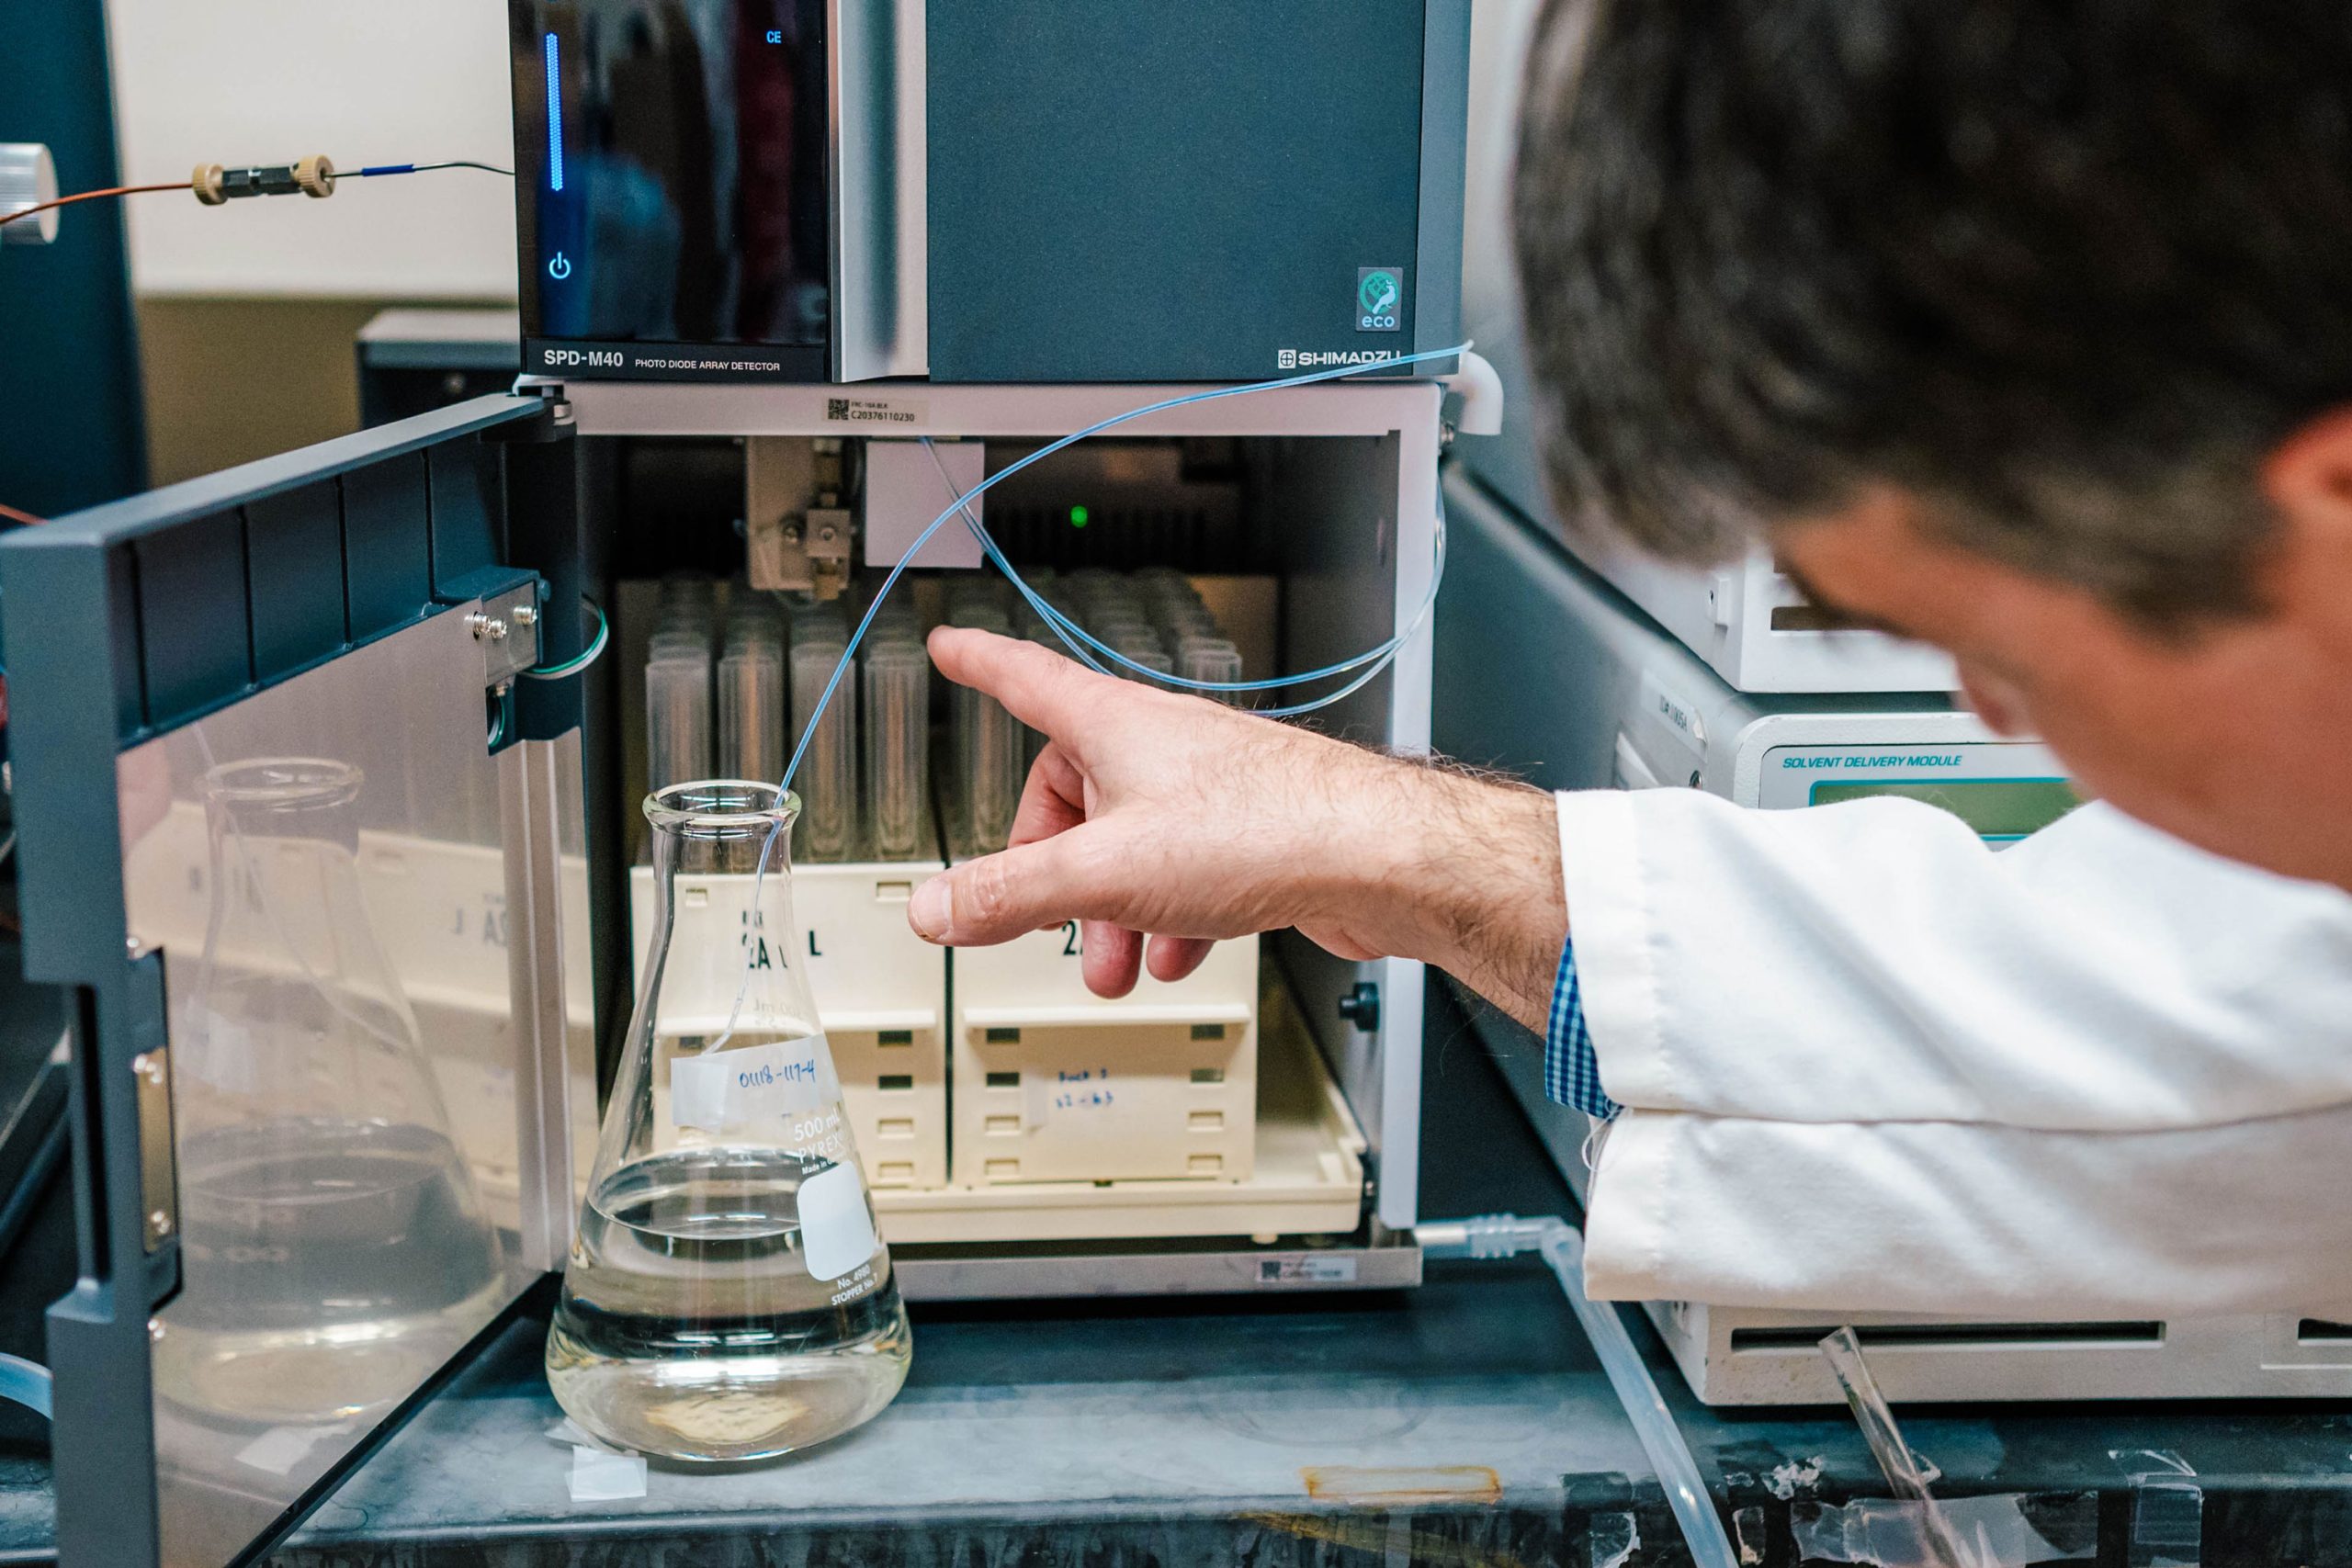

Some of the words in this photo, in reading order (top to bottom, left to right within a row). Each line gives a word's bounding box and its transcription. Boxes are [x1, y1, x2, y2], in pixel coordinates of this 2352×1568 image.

[766, 30, 782, 44] CE
[1362, 316, 1395, 327] eco
[544, 349, 624, 367] SPD-M40
[635, 359, 666, 368] PHOTO
[668, 360, 697, 369] DIODE
[699, 361, 729, 369] ARRAY
[731, 362, 780, 371] DETECTOR
[1298, 350, 1401, 367] SHIMADZU
[851, 411, 915, 422] C20376110230
[1782, 757, 1842, 769] SOLVENT
[1844, 757, 1905, 768] DELIVERY
[1906, 755, 1962, 767] MODULE
[794, 1117, 823, 1142] 500
[798, 1132, 845, 1164] PYREX
[801, 1164, 820, 1175] Made
[837, 1278, 853, 1290] No.
[831, 1284, 865, 1306] STOPPER
